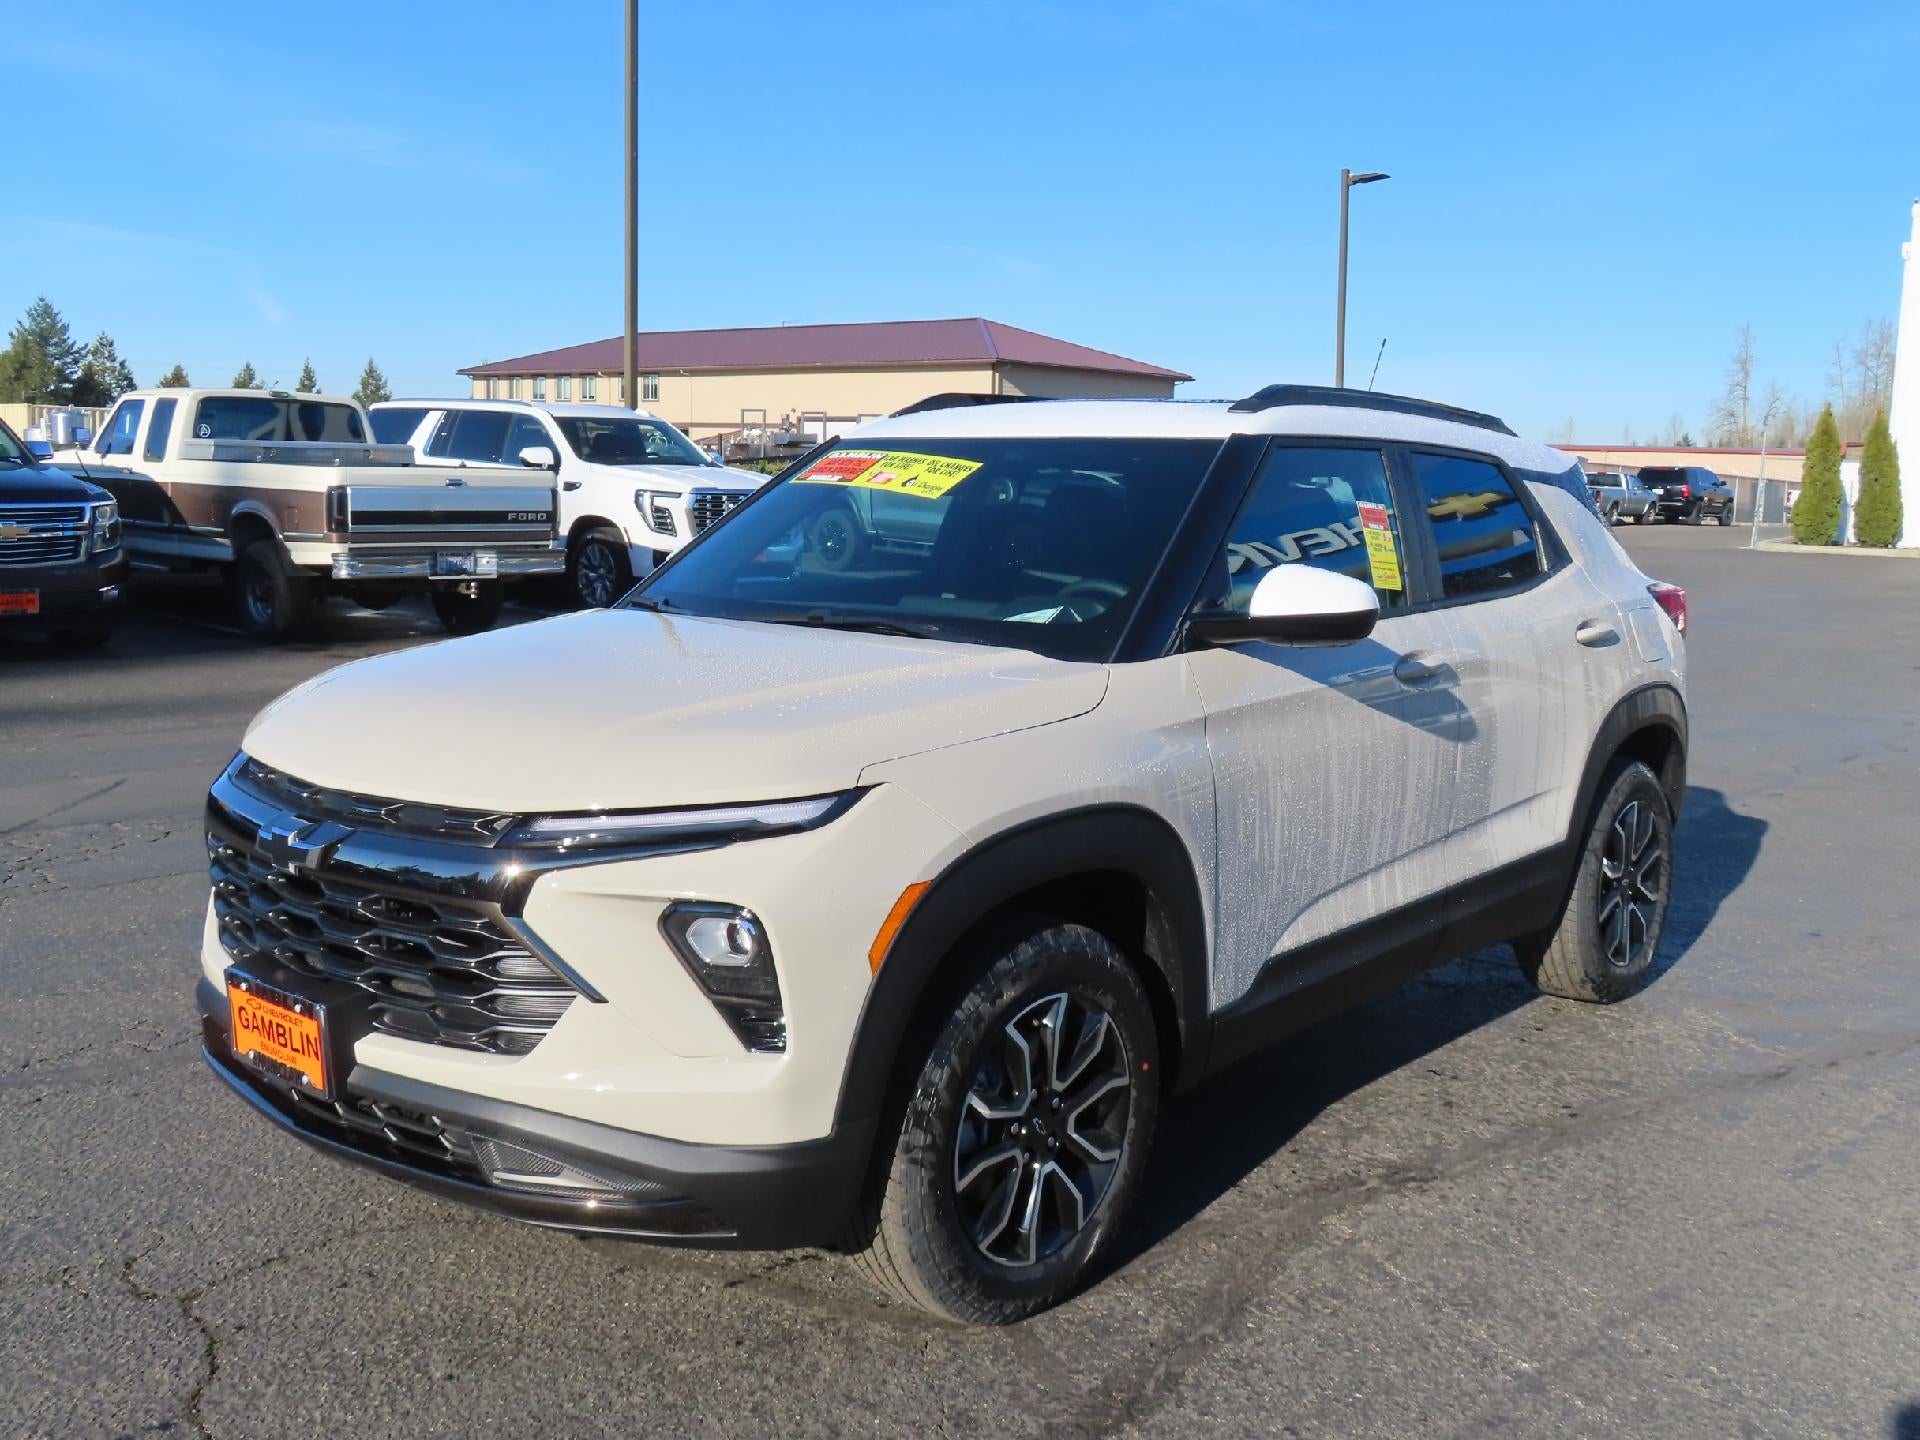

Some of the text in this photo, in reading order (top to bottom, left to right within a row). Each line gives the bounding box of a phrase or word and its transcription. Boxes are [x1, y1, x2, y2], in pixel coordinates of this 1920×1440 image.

[508, 512, 547, 521] FORD
[262, 1006, 304, 1028] CHEVROLET
[238, 1006, 320, 1061] GAMBLIN
